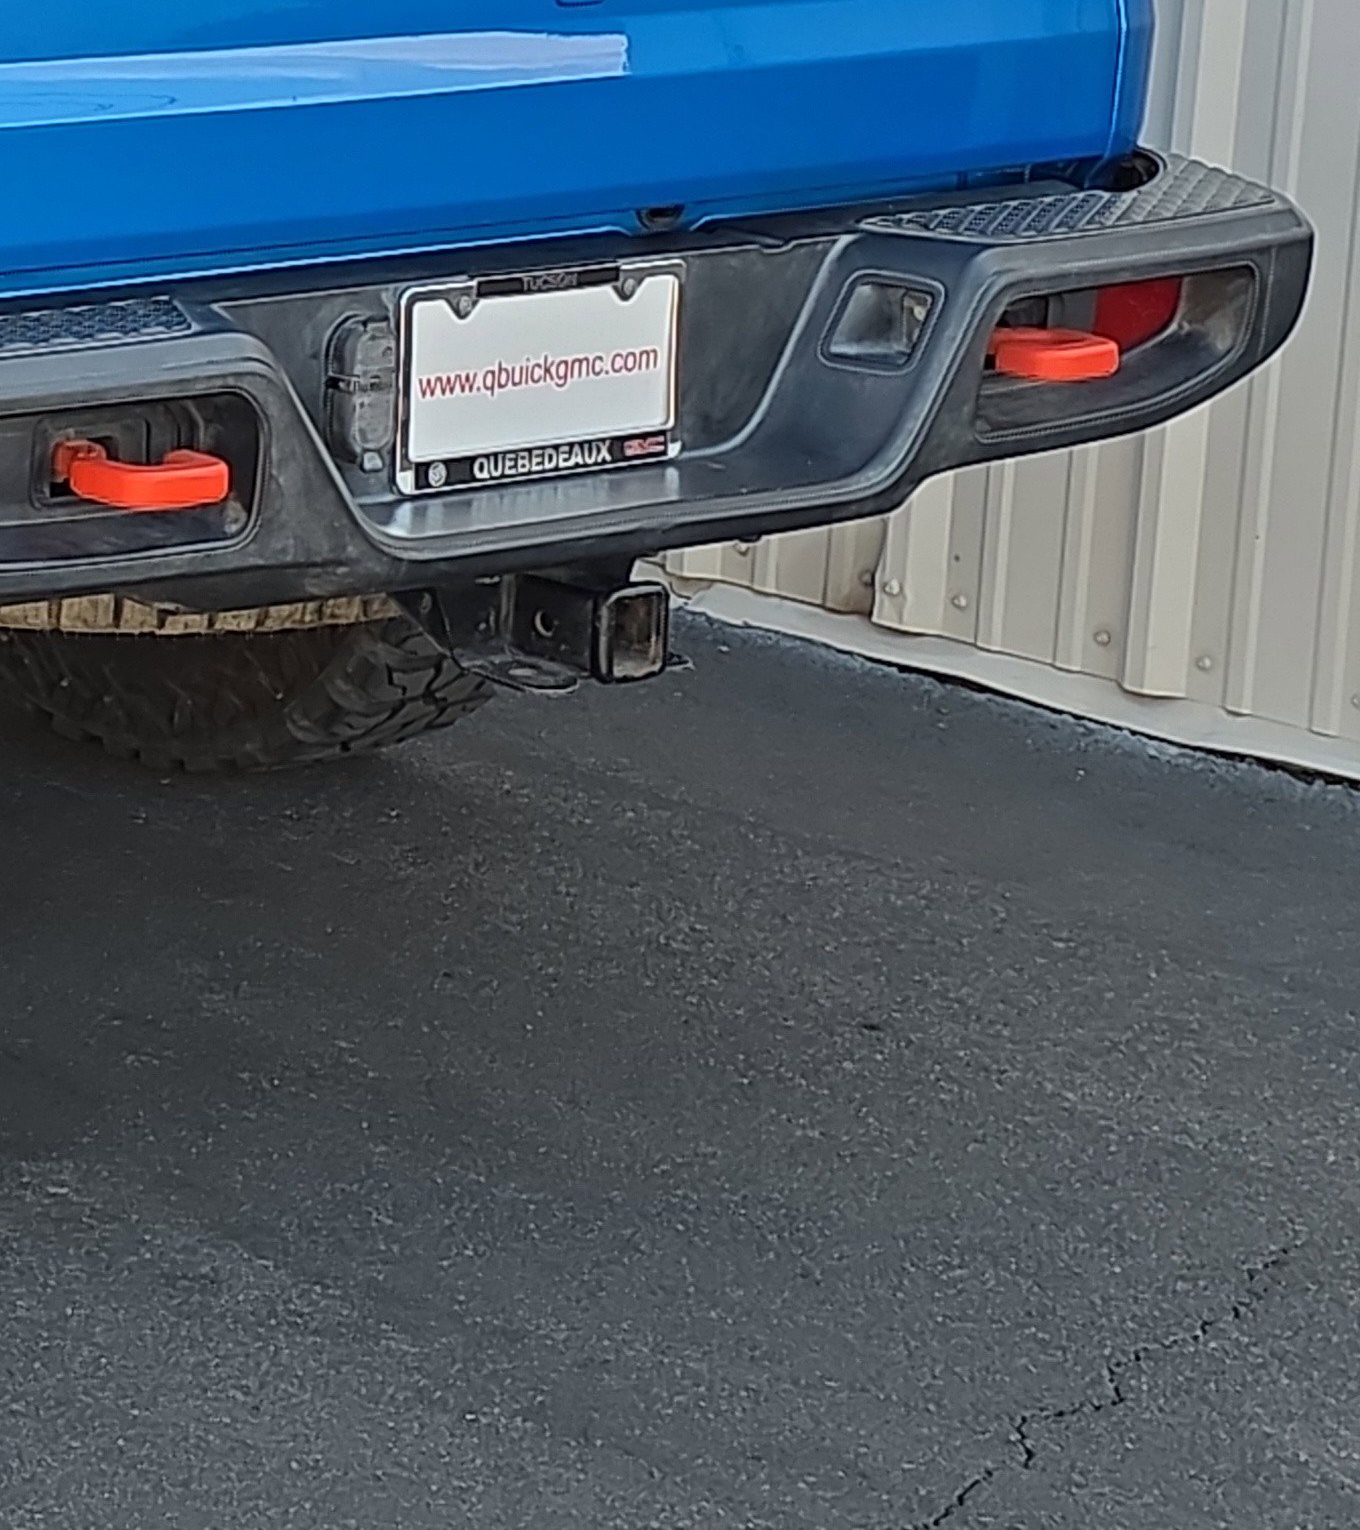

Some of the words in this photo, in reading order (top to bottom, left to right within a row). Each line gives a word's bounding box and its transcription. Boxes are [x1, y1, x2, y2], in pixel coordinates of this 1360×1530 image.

[521, 272, 579, 292] TUCSON
[418, 347, 659, 399] www.qbuickgmc.com
[472, 439, 613, 480] QUEBEDEAUX
